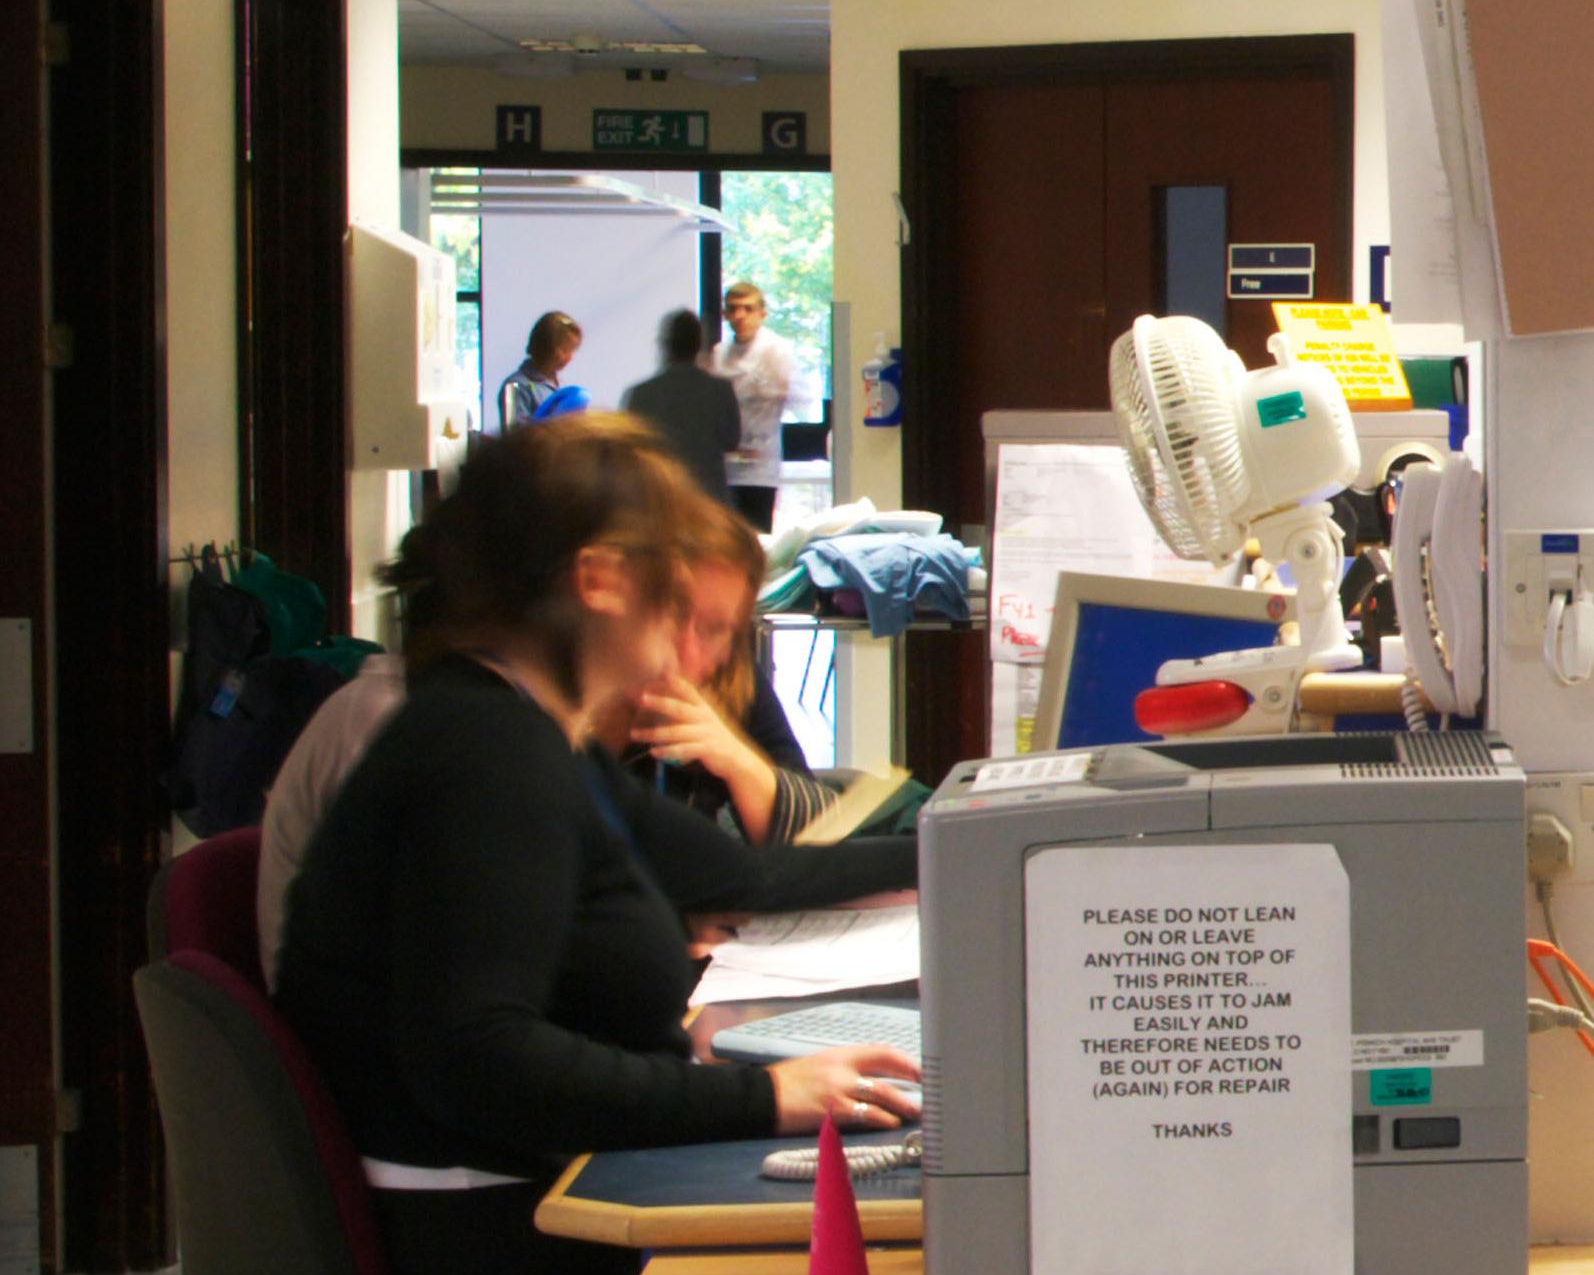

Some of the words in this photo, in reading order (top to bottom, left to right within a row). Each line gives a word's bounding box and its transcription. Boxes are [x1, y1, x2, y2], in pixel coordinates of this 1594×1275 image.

[506, 112, 532, 143] H
[597, 116, 633, 129] FIRE
[597, 132, 634, 145] EXIT
[770, 118, 798, 150] G
[1083, 909, 1158, 924] PLEASE
[1164, 908, 1193, 924] DO
[1199, 907, 1239, 923] NOT
[1245, 906, 1296, 922] LEAN
[1124, 931, 1152, 945] ON
[1159, 930, 1187, 945] OR
[1193, 929, 1255, 944] LEAVE
[1084, 951, 1186, 967] ANYTHING
[1191, 951, 1219, 966] ON
[1226, 950, 1264, 965] TOP
[1270, 949, 1295, 965] OF
[1114, 974, 1158, 989] THIS
[1090, 996, 1106, 1011] IT
[1112, 995, 1192, 1011] CAUSES
[1198, 994, 1213, 1009] IT
[1220, 993, 1246, 1009] TO
[1252, 992, 1292, 1008] JAM
[1134, 1017, 1201, 1032] EASILY
[1207, 1015, 1248, 1030] AND
[1081, 1038, 1198, 1054] THEREFORE
[1204, 1036, 1270, 1052] NEEDS
[1275, 1035, 1301, 1050] TO
[1100, 1061, 1125, 1075] BE
[1132, 1060, 1171, 1075] OUT
[1178, 1059, 1203, 1074] OF
[1209, 1057, 1283, 1073] ACTION
[1093, 1081, 1169, 1100] (AGAIN)
[1174, 1080, 1213, 1095] FOR
[1219, 1078, 1290, 1094] REPAIR
[1152, 1122, 1233, 1139] THANKS
